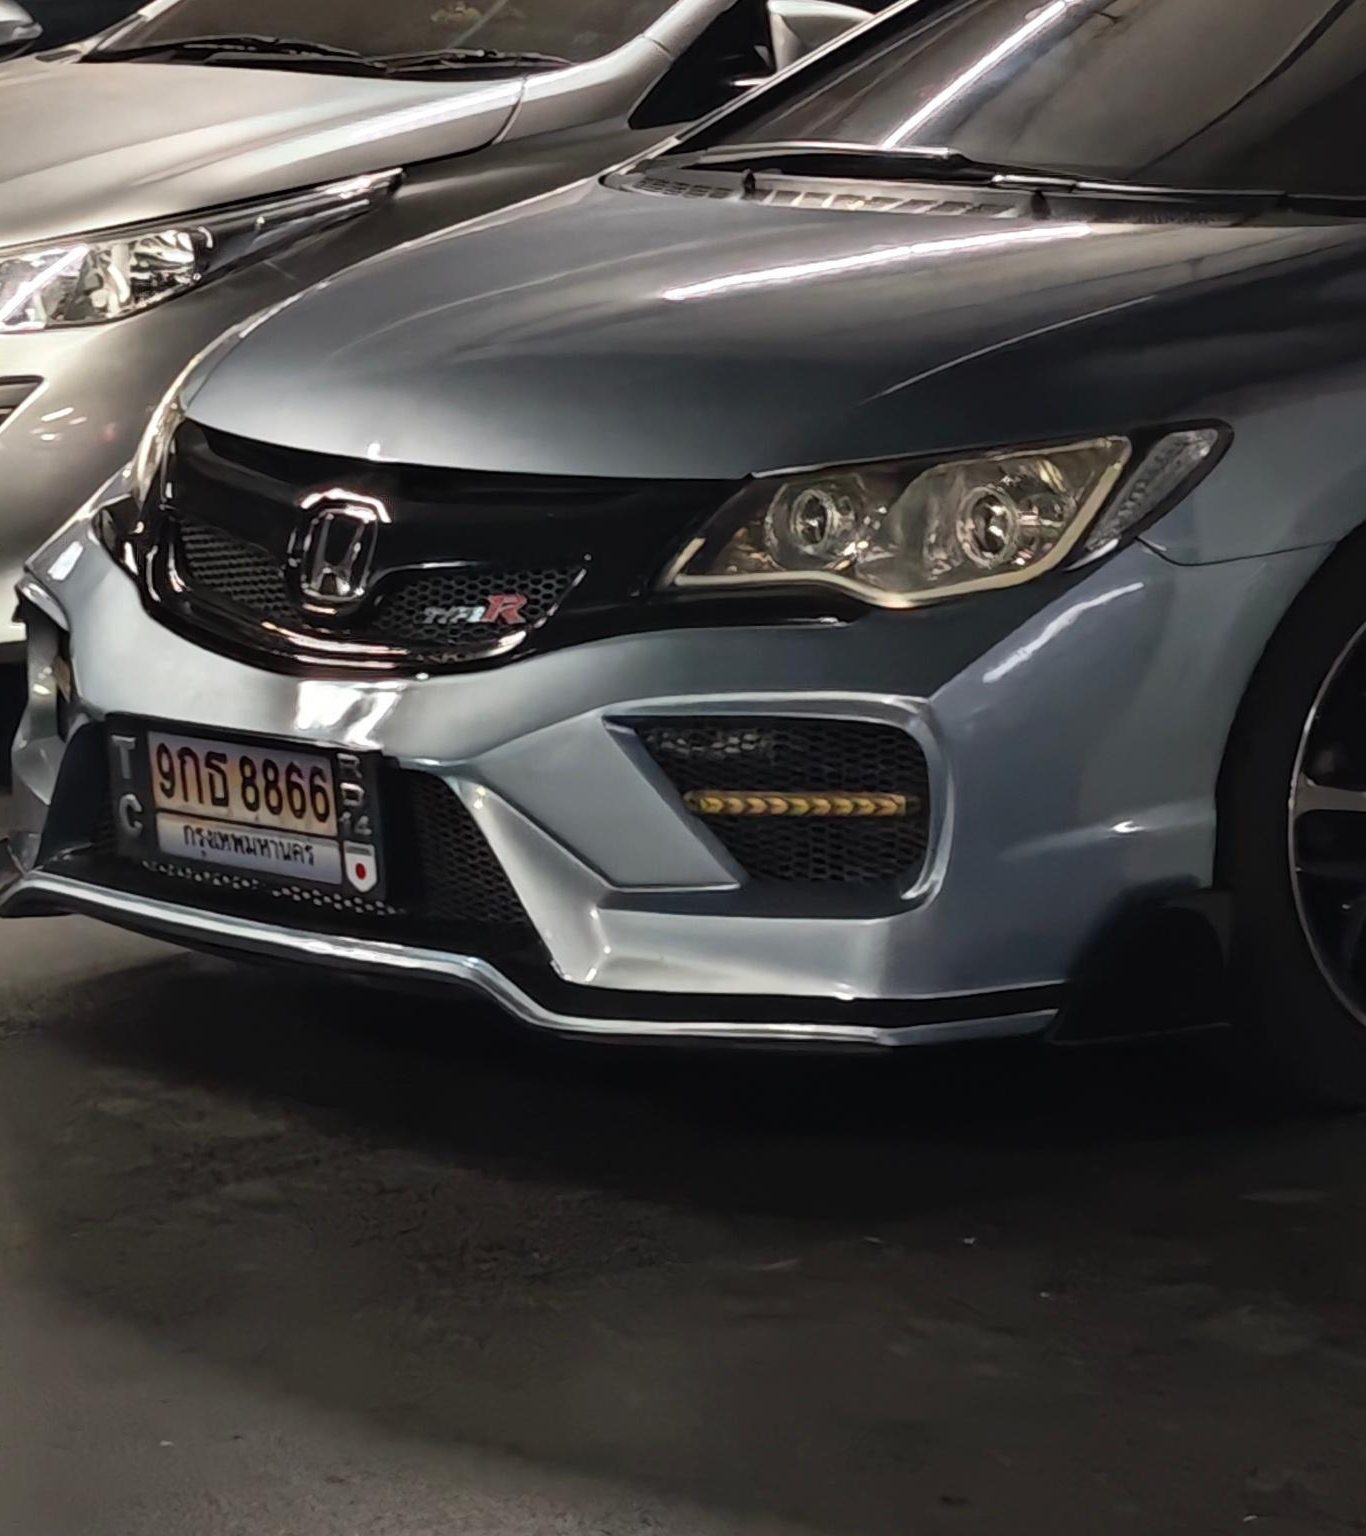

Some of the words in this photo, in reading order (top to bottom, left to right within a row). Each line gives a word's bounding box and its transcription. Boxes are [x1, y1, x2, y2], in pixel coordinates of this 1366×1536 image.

[481, 593, 528, 624] R
[156, 742, 230, 807] 9กธ
[239, 754, 331, 824] 8866
